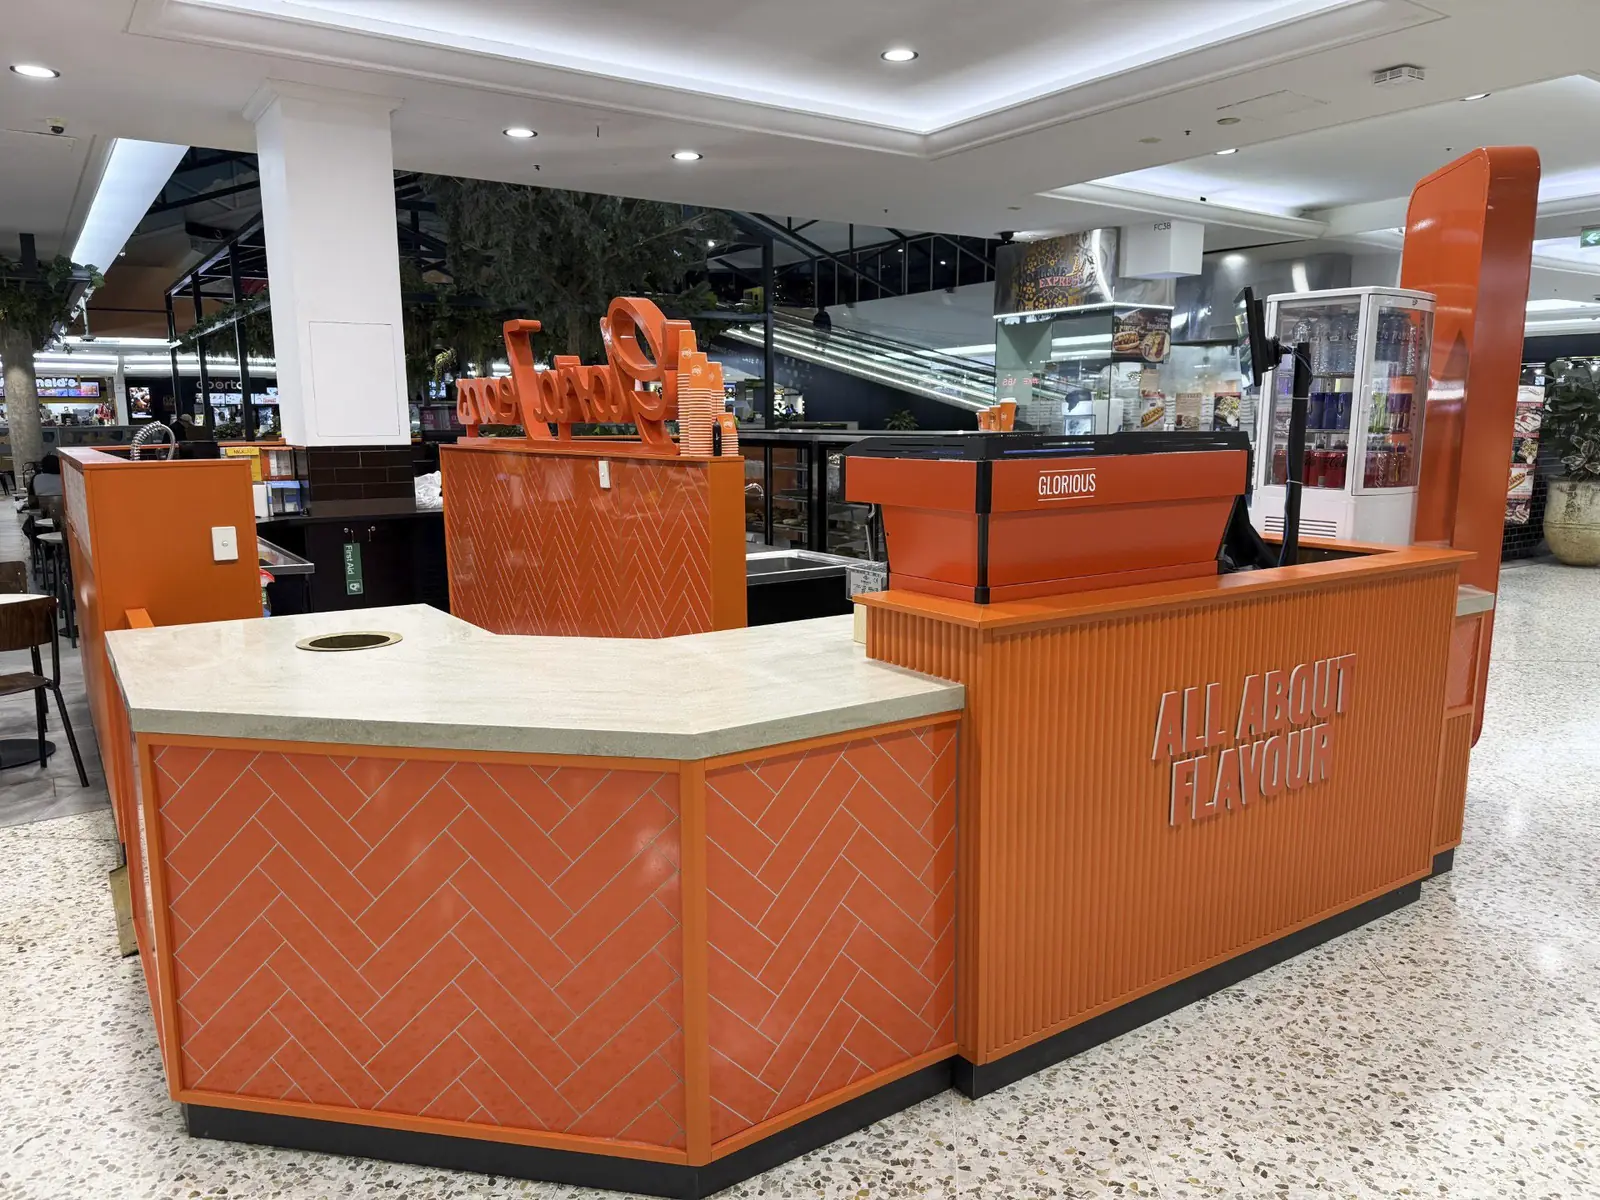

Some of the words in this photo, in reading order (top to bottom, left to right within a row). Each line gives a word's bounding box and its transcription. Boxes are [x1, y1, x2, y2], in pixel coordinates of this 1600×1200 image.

[1038, 473, 1097, 495] GLORIOUS
[345, 545, 353, 561] First
[347, 562, 355, 575] Aid
[1151, 682, 1228, 761] ALL
[1235, 653, 1356, 740] ABOUT
[1169, 723, 1335, 826] FLAVOUR
